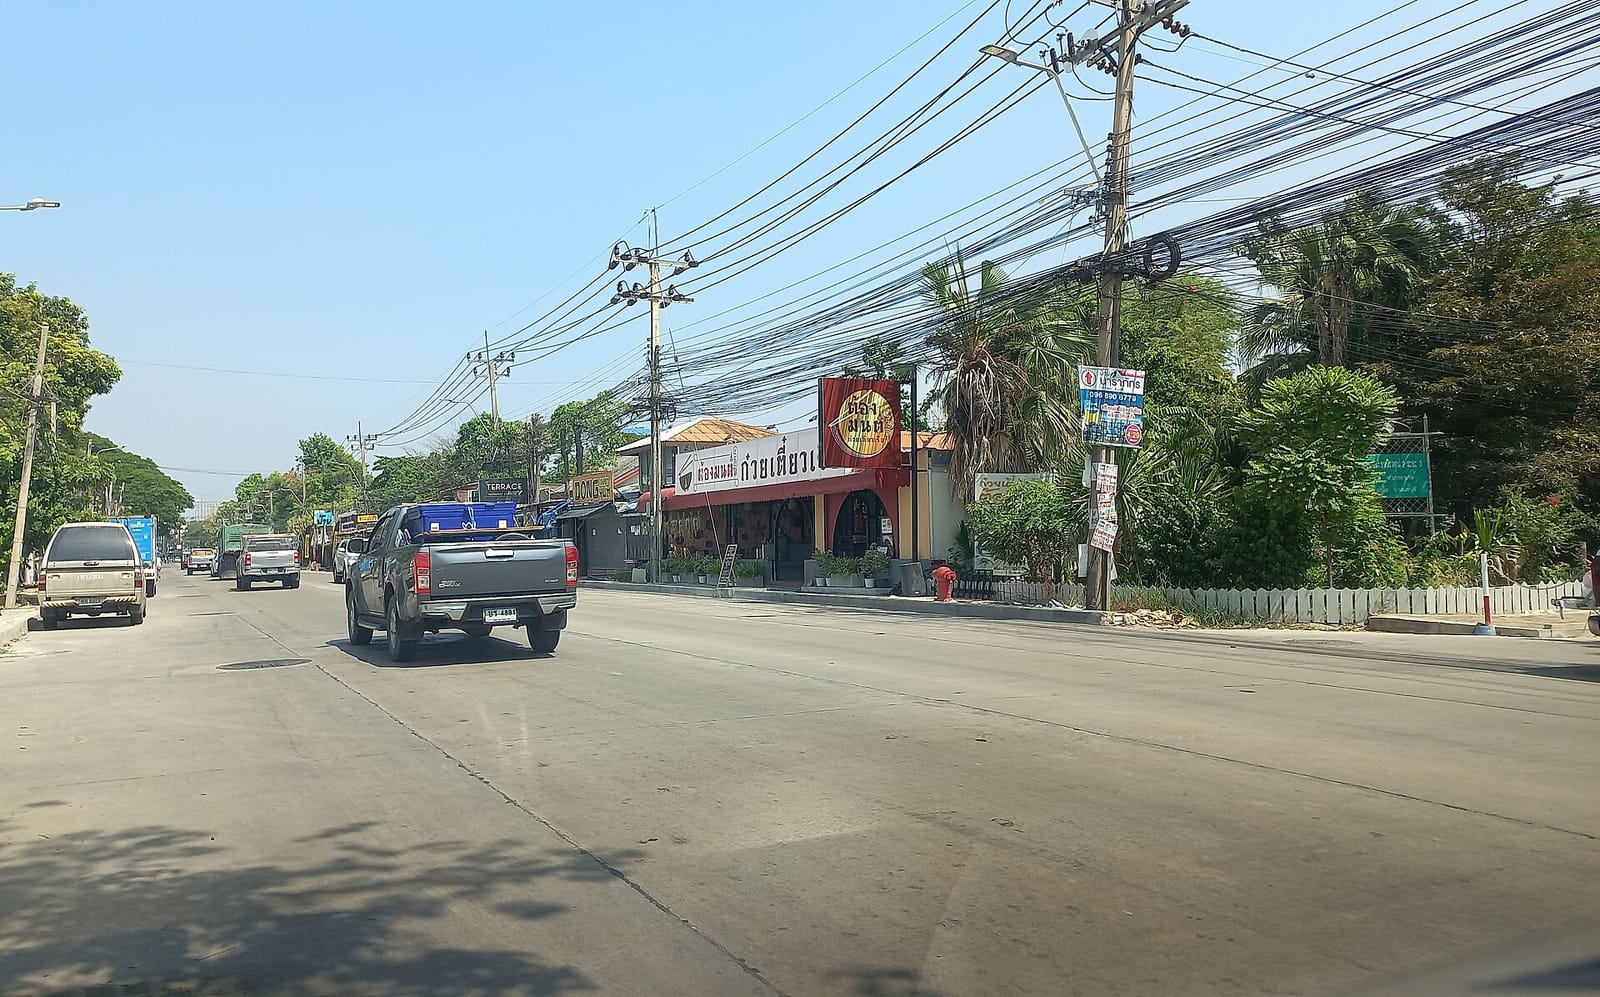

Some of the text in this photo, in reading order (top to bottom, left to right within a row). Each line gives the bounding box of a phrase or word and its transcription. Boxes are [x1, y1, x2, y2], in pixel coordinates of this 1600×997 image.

[741, 435, 825, 481] ก๋วยเตี๋ยวเ
[486, 482, 522, 491] TERRACE
[575, 479, 599, 501] DONG
